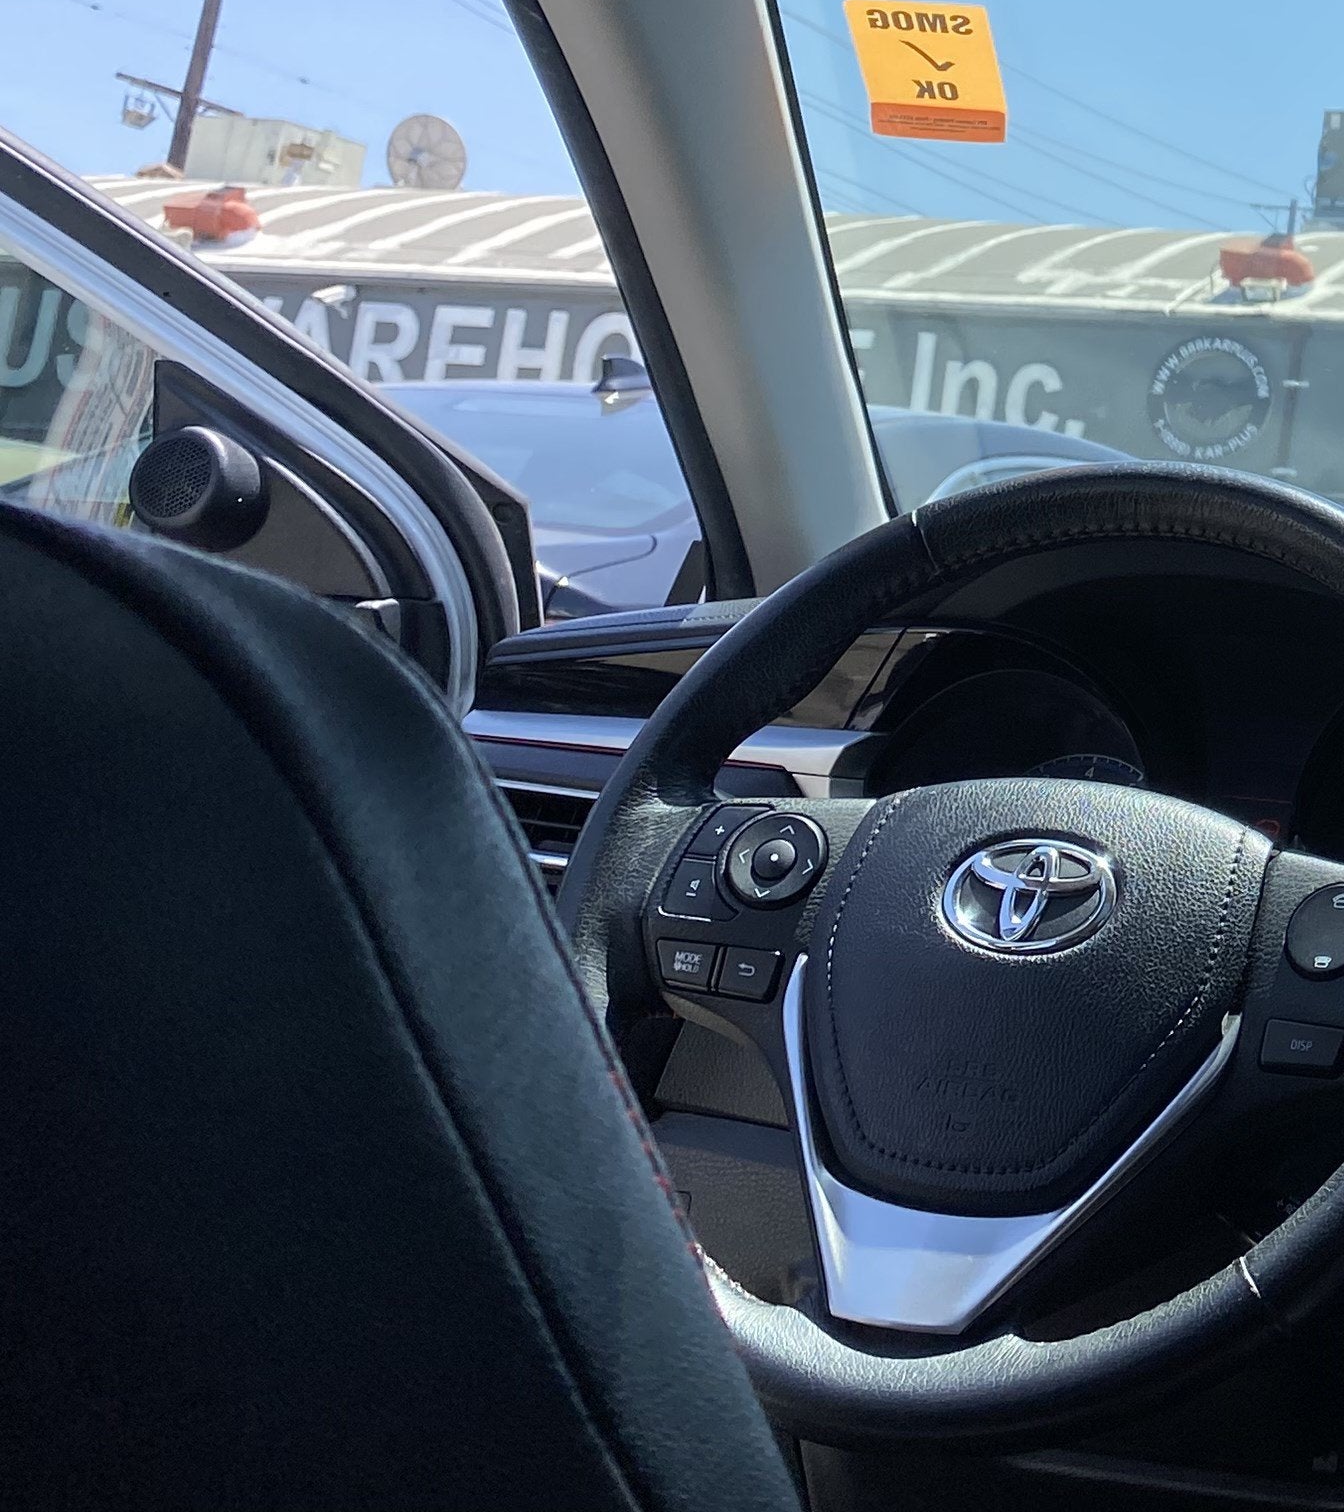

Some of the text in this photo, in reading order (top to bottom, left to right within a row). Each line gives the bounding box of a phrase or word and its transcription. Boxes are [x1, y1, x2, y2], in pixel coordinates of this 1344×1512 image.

[910, 331, 1086, 439] Inc.
[1083, 766, 1095, 778] 4
[673, 951, 702, 964] MODE
[1290, 1039, 1313, 1052] DISP
